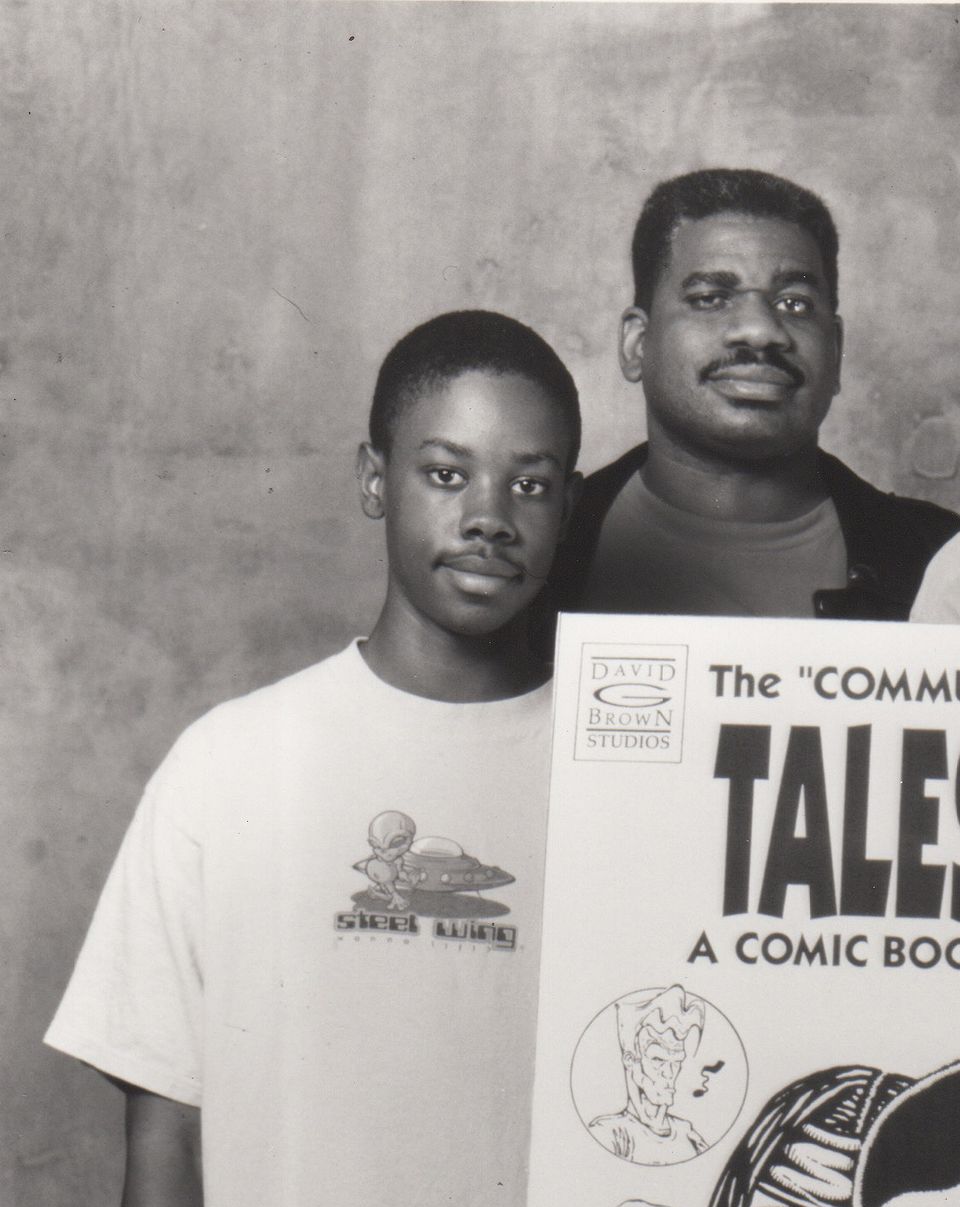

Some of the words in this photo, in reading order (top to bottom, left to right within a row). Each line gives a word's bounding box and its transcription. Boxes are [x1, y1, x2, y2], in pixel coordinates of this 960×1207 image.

[709, 664, 781, 699] The
[586, 734, 670, 750] STUDIOS
[687, 930, 719, 964] A
[735, 931, 868, 969] COMIC
